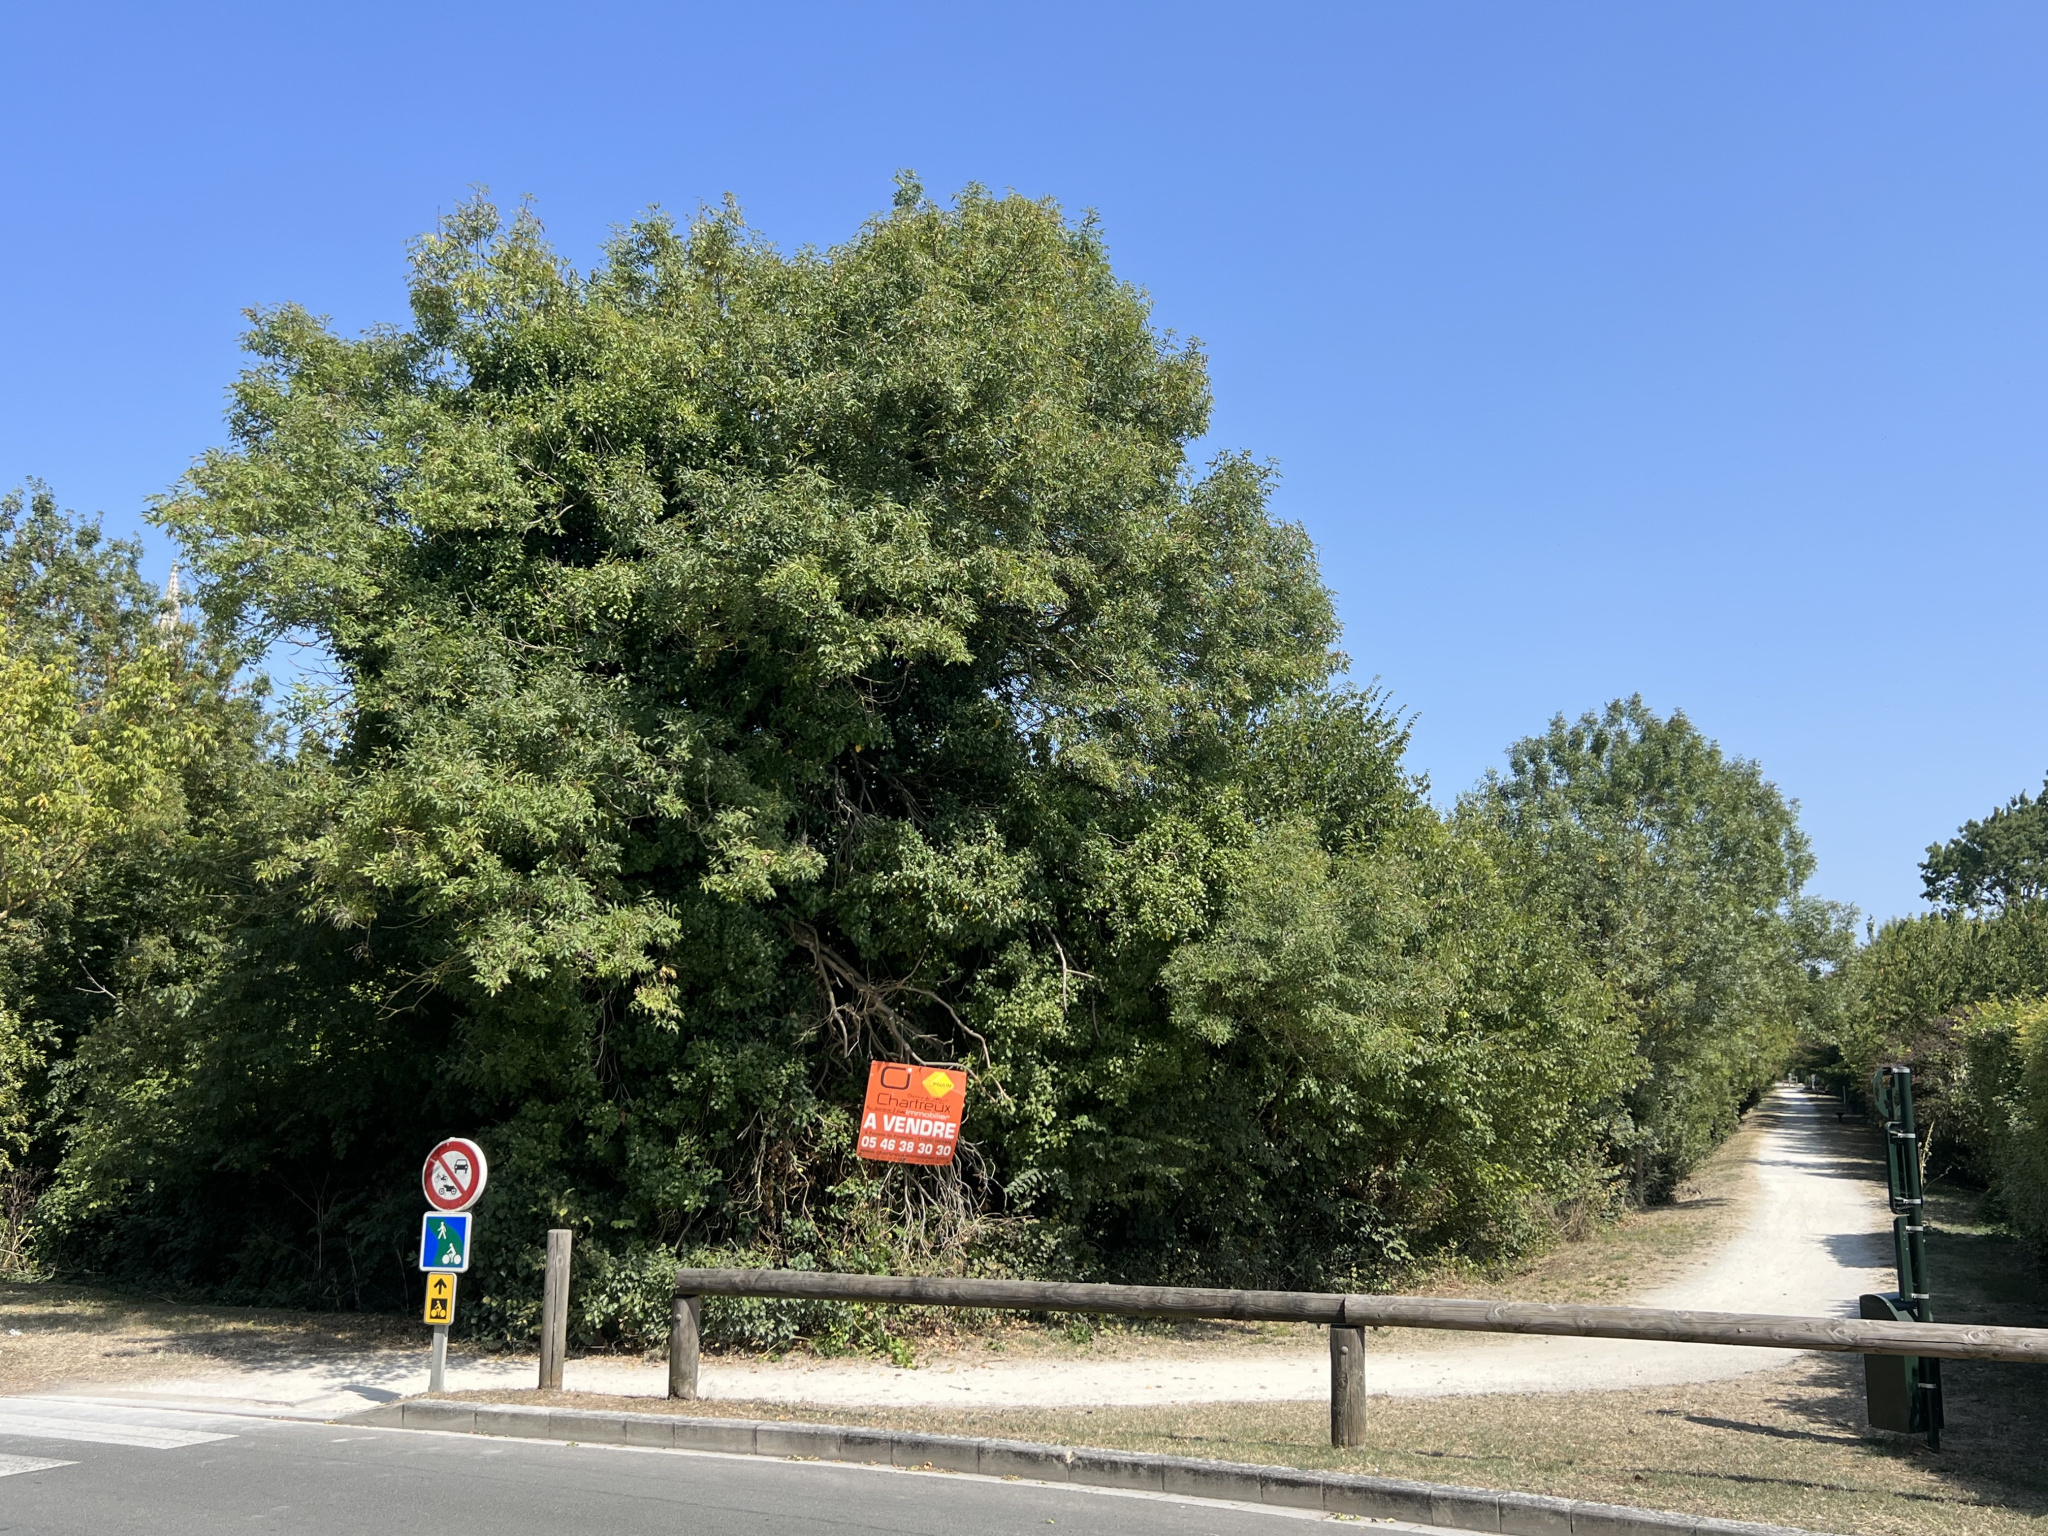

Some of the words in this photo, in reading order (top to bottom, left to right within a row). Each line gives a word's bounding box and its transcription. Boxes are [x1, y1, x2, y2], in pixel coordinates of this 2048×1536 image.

[877, 1093, 951, 1113] Chartreux
[863, 1112, 877, 1130] A
[883, 1115, 957, 1139] VENDRE
[861, 1135, 877, 1149] 05
[879, 1137, 896, 1151] 46
[898, 1140, 915, 1153] 38
[917, 1142, 933, 1155] 30
[935, 1144, 952, 1157] 30
